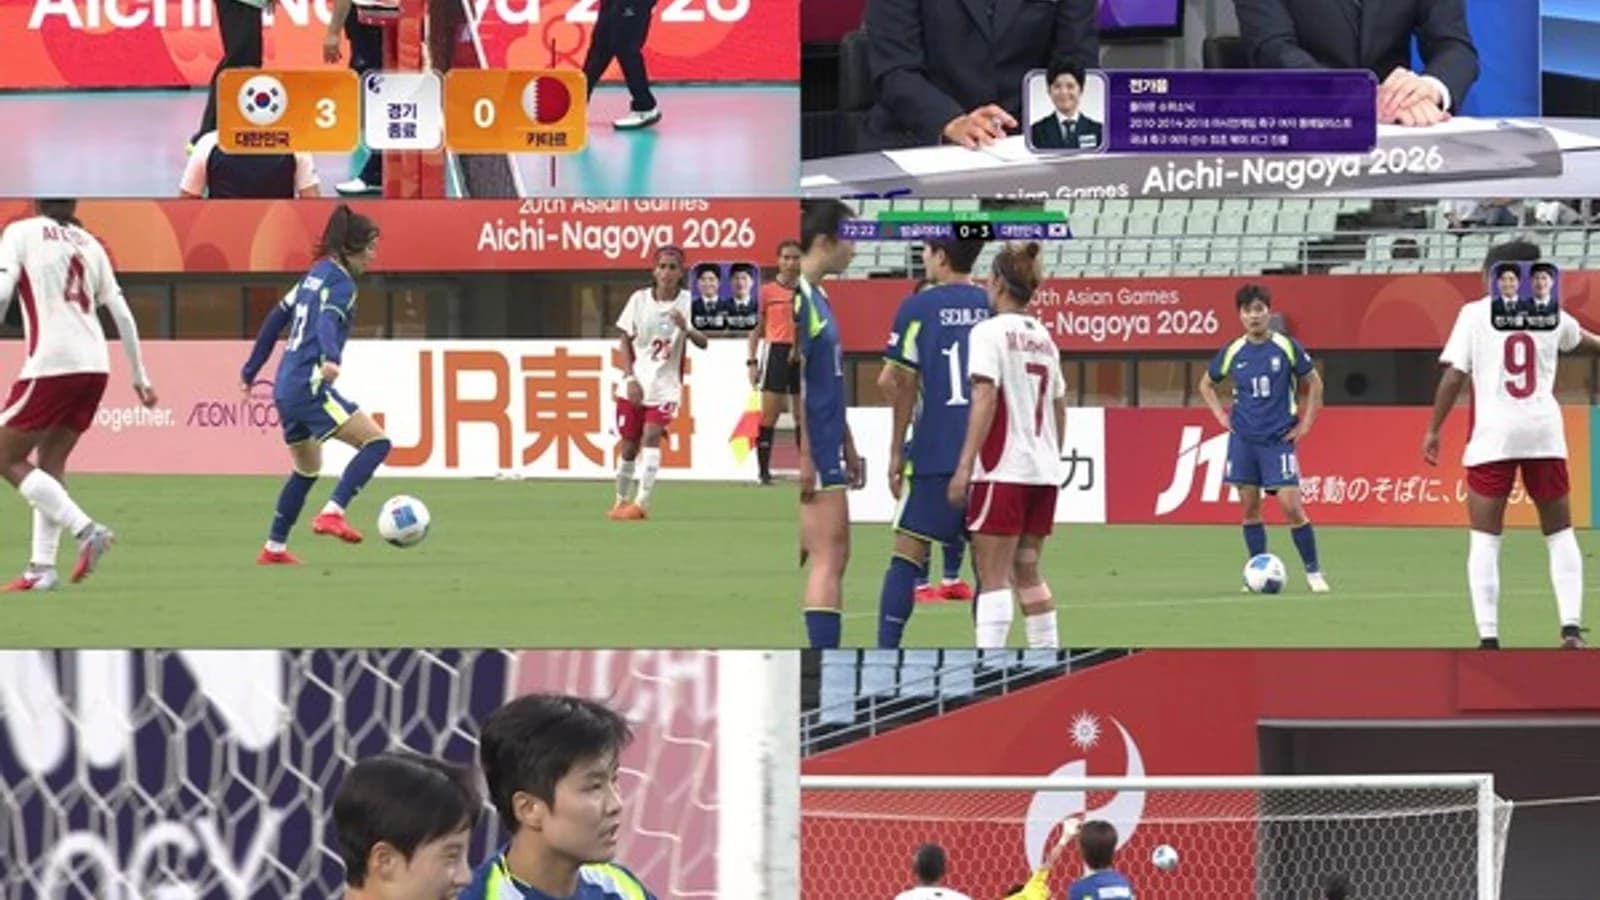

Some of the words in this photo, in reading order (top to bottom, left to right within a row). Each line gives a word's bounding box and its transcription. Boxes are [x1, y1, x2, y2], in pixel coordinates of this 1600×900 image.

[1141, 155, 1361, 195] Aichi-Nagoya
[1368, 146, 1444, 175] 2026
[477, 219, 673, 258] Aichi-Nagoya
[682, 218, 756, 248] 2026
[64, 254, 91, 314] 4
[1065, 287, 1113, 305] Asian
[1117, 287, 1181, 305] Games
[1157, 310, 1220, 334] 2026
[1504, 332, 1537, 399] 9
[1025, 363, 1049, 436] 7
